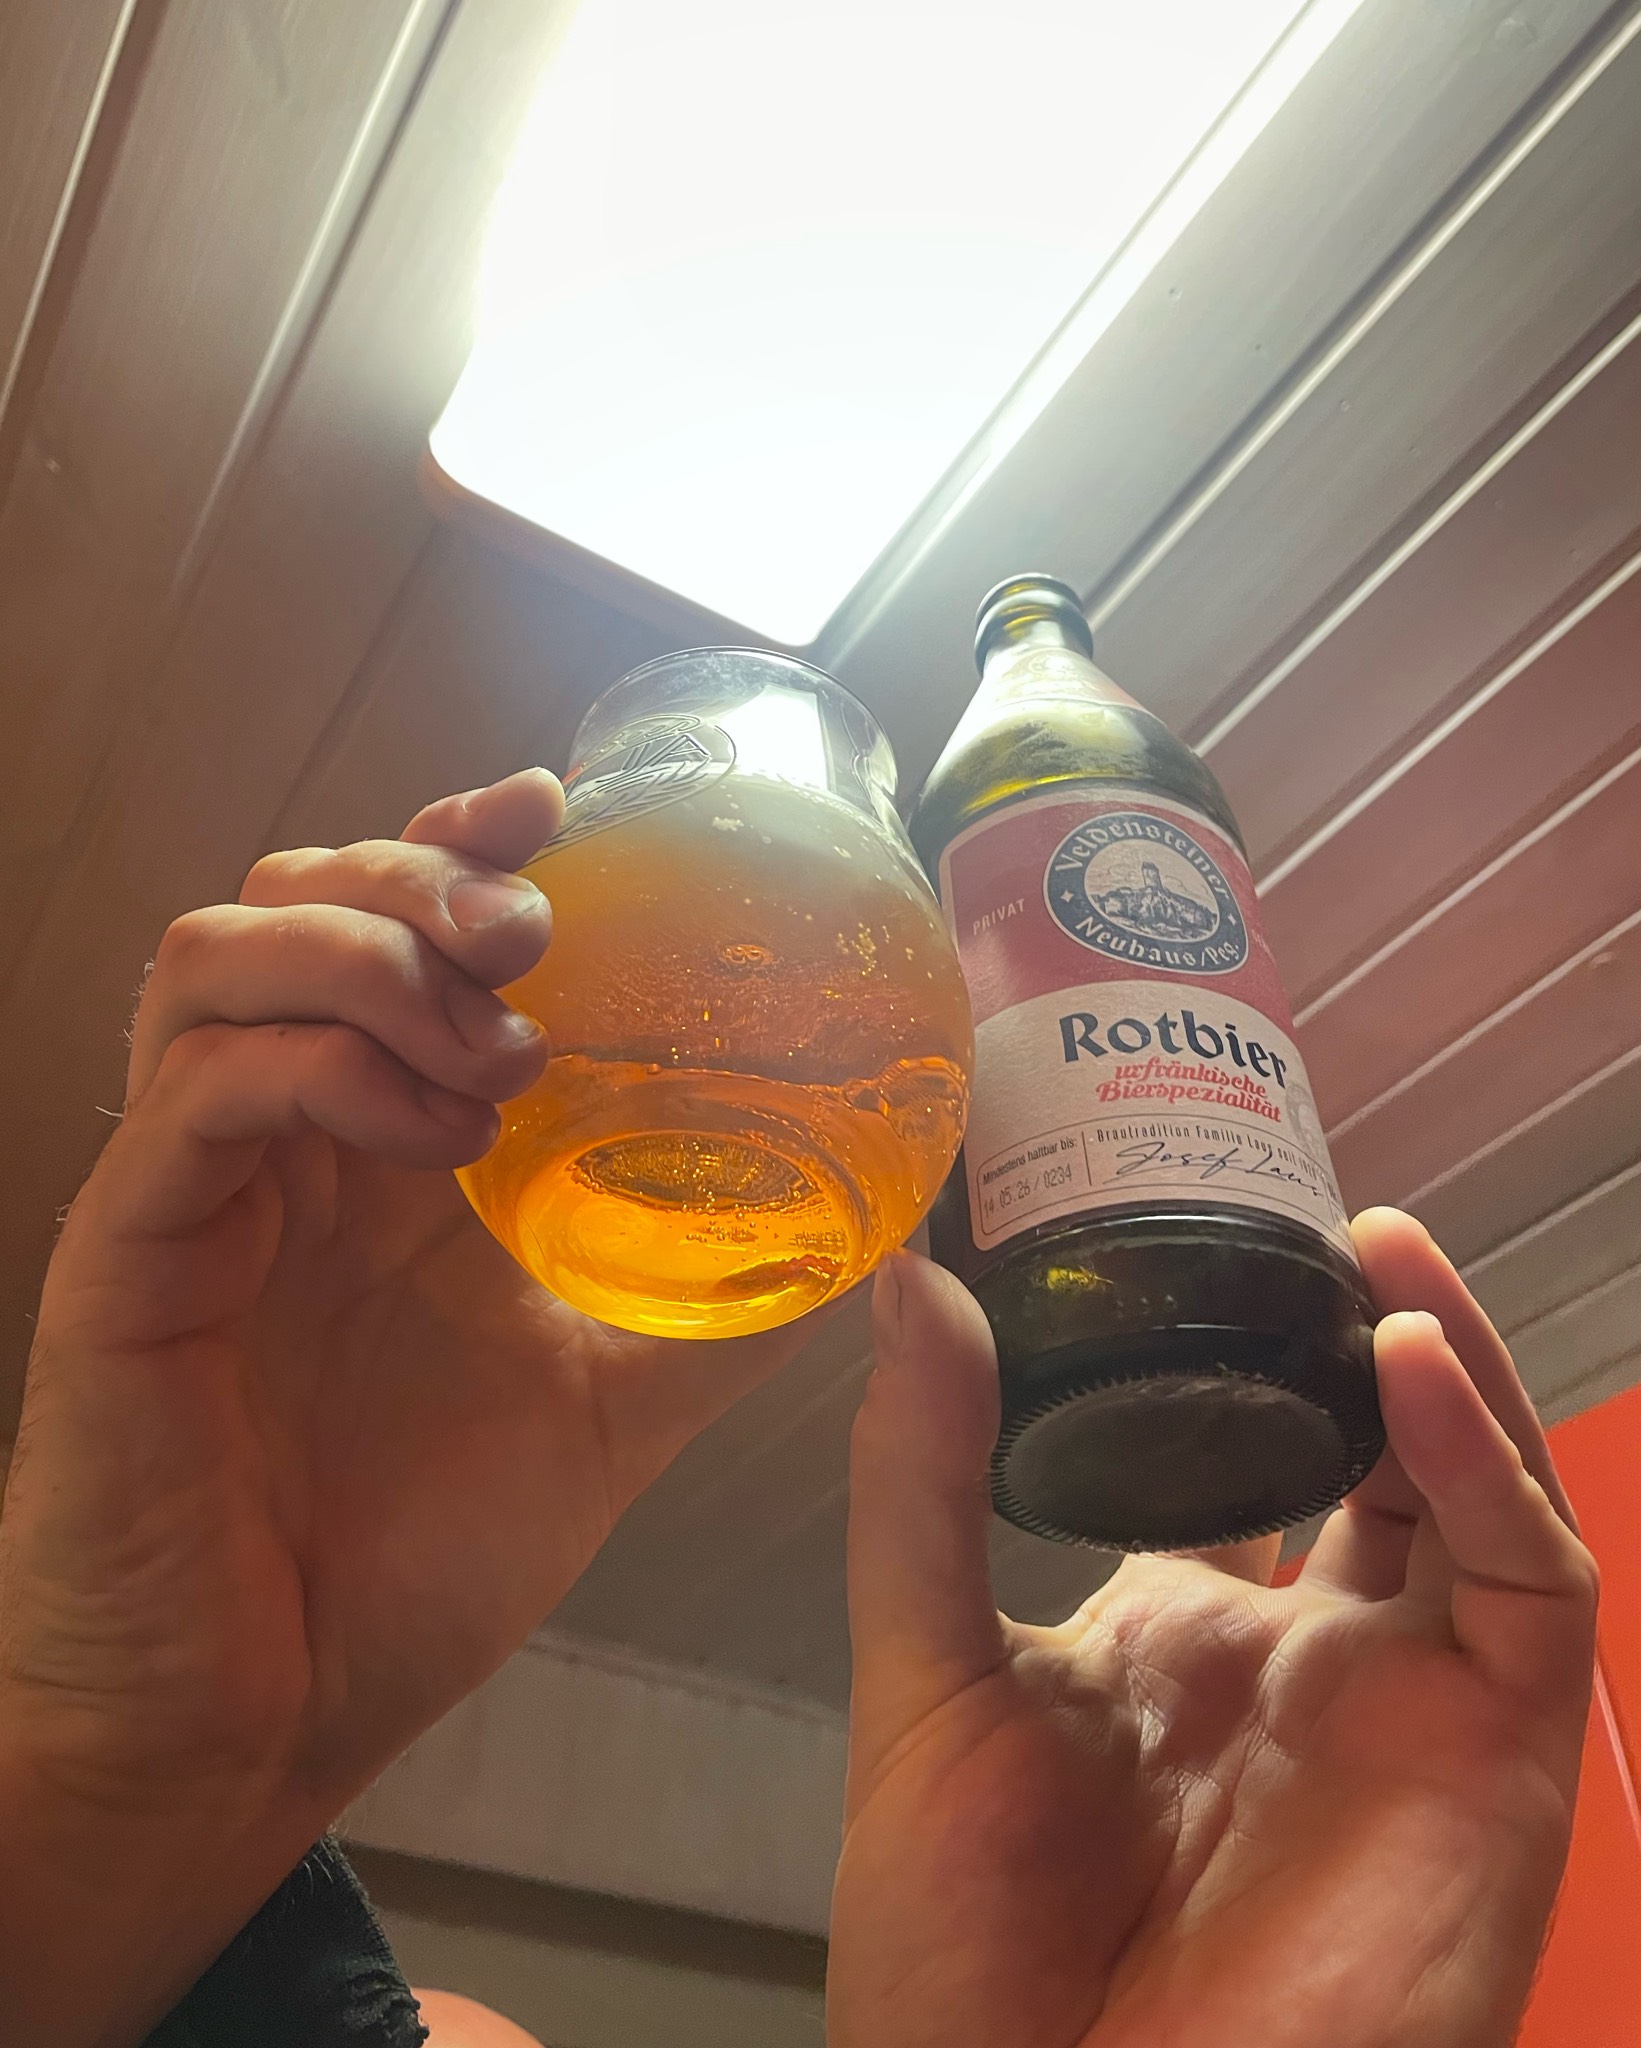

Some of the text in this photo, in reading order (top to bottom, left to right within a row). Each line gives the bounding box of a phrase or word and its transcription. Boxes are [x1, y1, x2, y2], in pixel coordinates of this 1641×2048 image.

[1054, 820, 1230, 900] Veldensteiner
[973, 898, 1025, 936] PRIVAT
[1059, 1009, 1287, 1089] Rotbier
[1114, 1055, 1268, 1099] urfränkische
[1096, 1080, 1282, 1123] Bierspezialität
[1096, 1122, 1191, 1142] Brautradition
[1195, 1125, 1242, 1146] Familie
[983, 1153, 1026, 1185] Mindestens
[1027, 1142, 1058, 1162] haltbar
[1043, 1162, 1073, 1189] 0234
